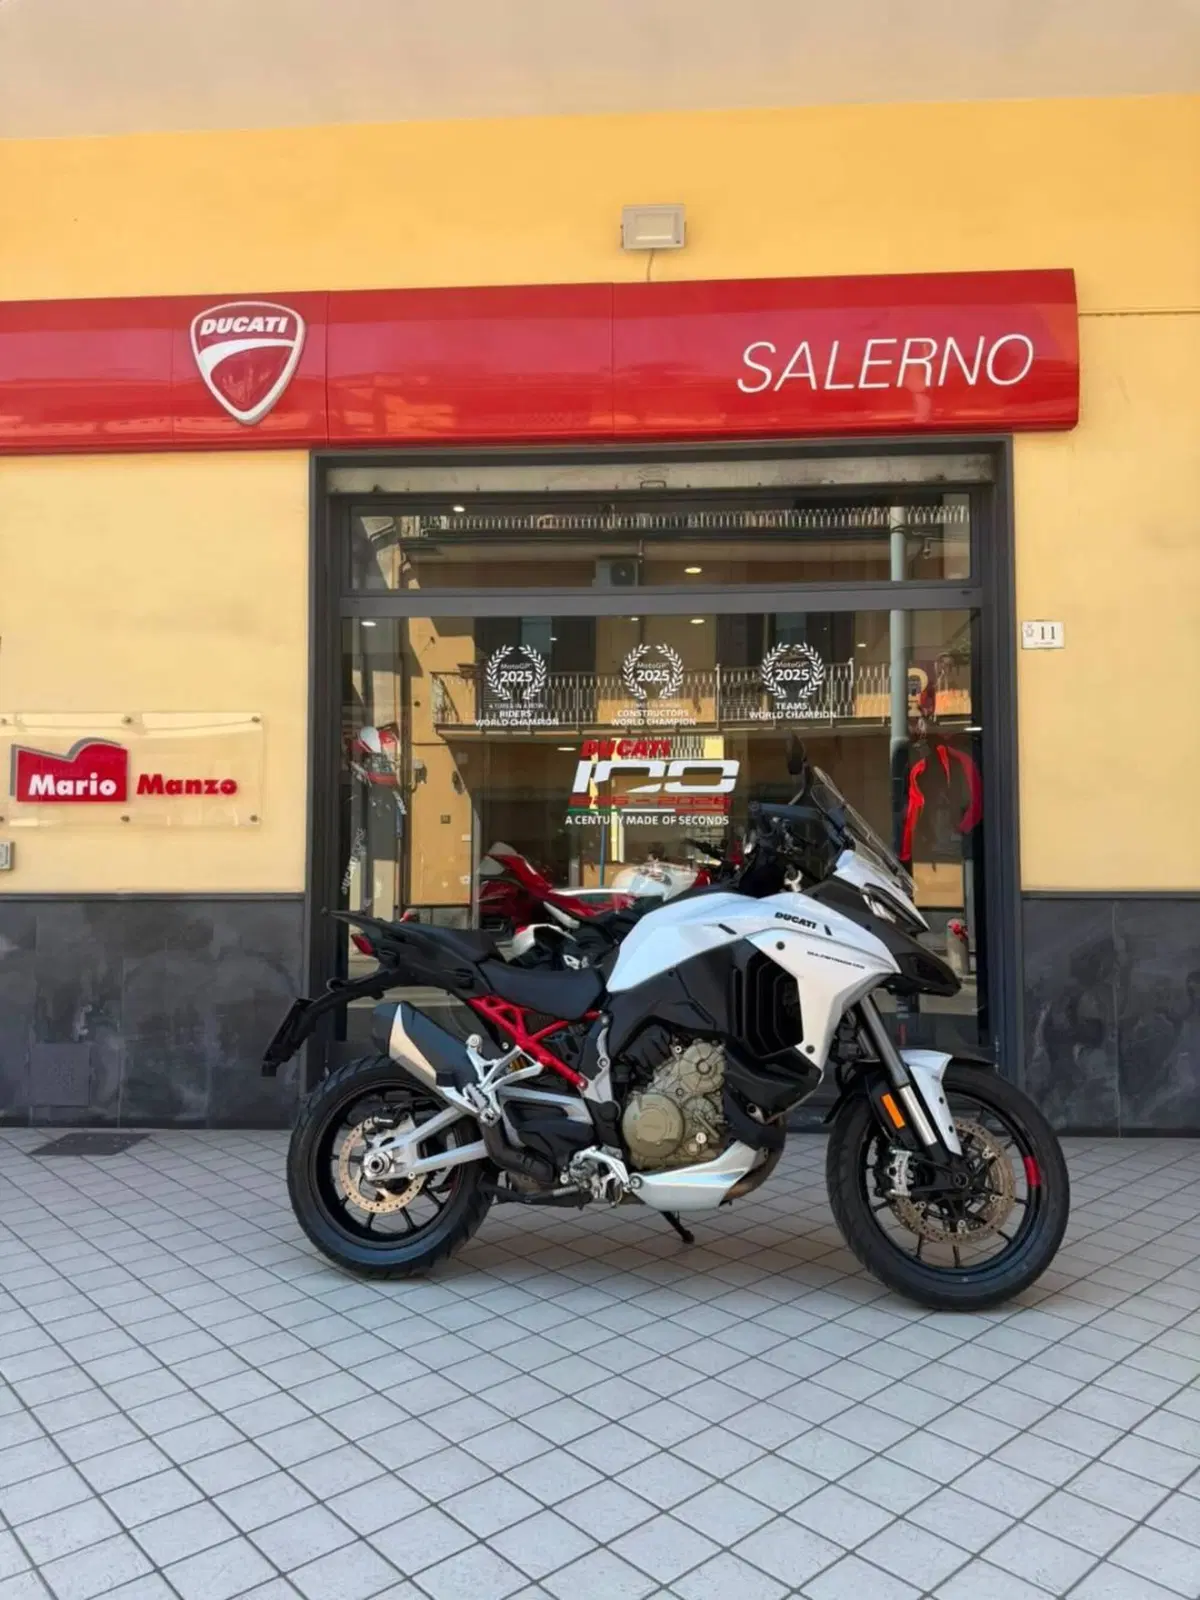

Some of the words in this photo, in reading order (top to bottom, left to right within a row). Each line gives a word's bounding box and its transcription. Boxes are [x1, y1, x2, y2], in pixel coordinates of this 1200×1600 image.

[200, 316, 289, 336] DUCATI
[737, 333, 1034, 393] SALERNO
[1041, 626, 1055, 640] 11
[500, 671, 533, 683] 2025
[636, 669, 670, 682] 2025
[775, 668, 810, 681] 2025
[748, 710, 784, 719] WORLD
[785, 710, 837, 719] CHAMPION
[475, 718, 509, 727] WORLD
[510, 718, 560, 727] CHAMPION
[611, 718, 645, 727] WORLD
[646, 718, 697, 727] CHAMPION
[580, 739, 672, 758] DUCATI
[28, 772, 117, 796] Mario
[136, 774, 238, 795] Manzo
[565, 815, 574, 825] A
[575, 815, 624, 825] CENTUY
[626, 815, 658, 825] MADE
[662, 815, 677, 825] OF
[678, 815, 730, 825] SECONDS
[774, 911, 818, 929] DUCATI
